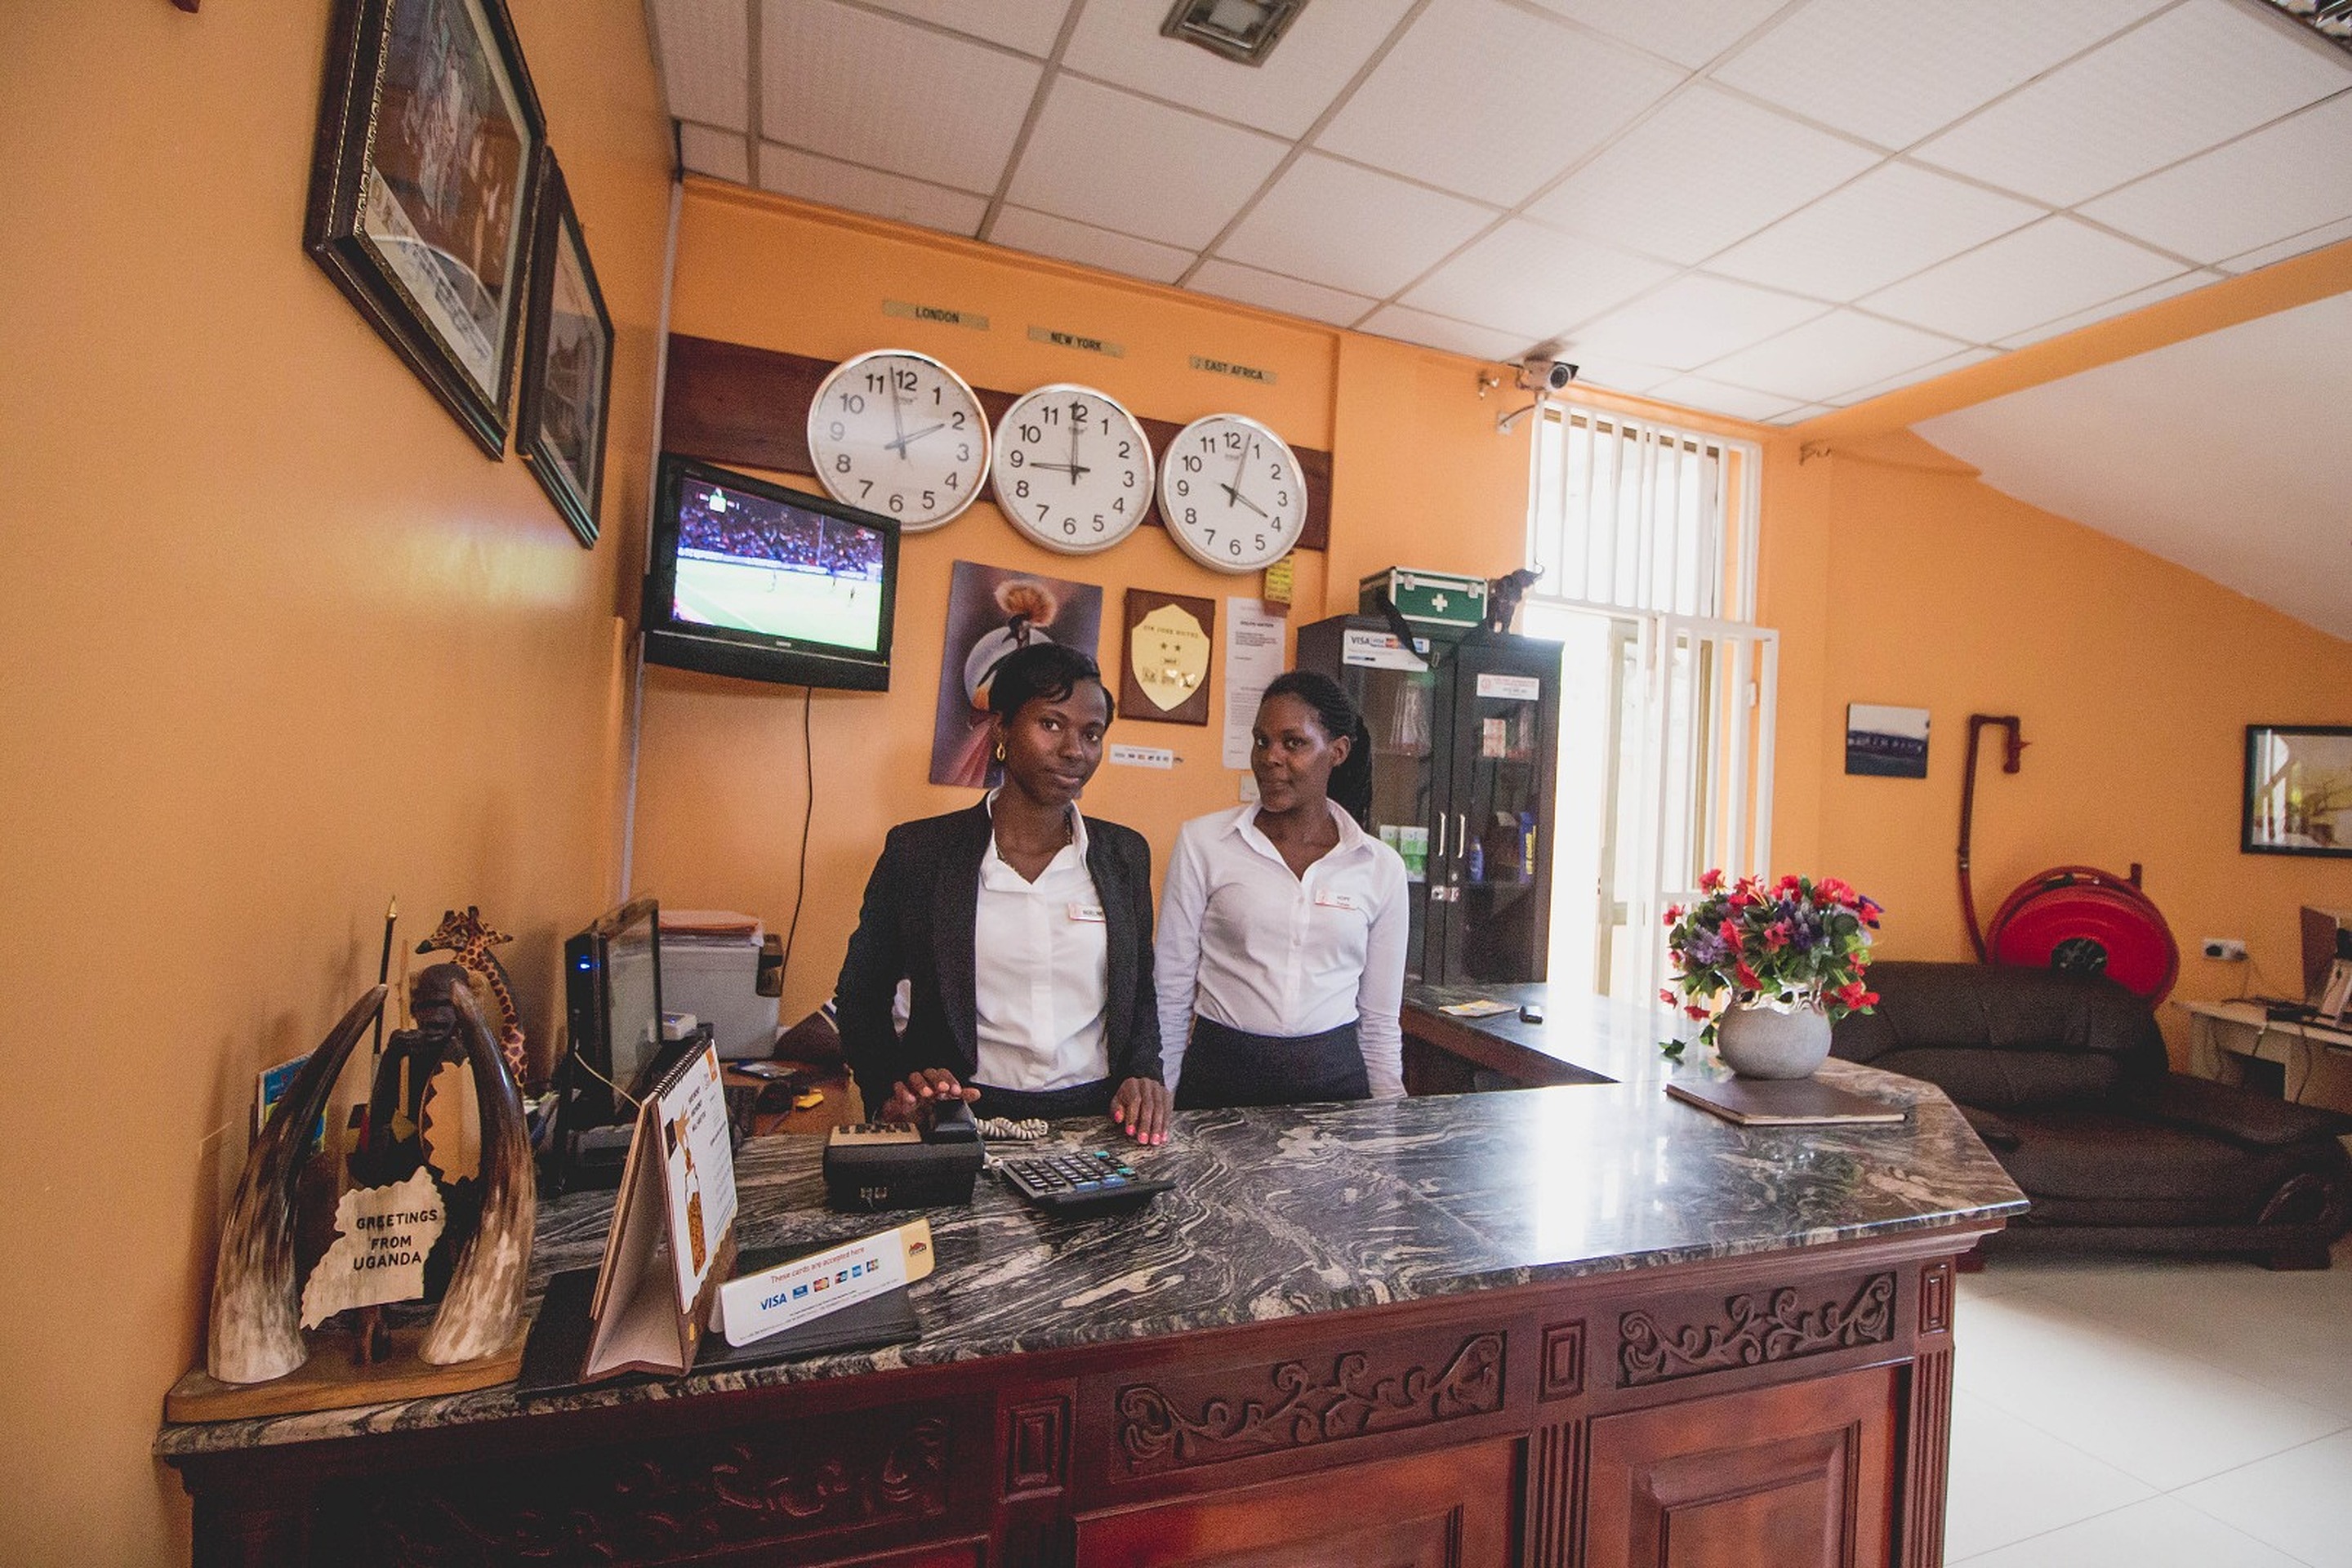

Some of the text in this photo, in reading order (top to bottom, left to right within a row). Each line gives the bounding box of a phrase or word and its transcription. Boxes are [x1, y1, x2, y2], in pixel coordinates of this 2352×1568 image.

[915, 306, 960, 324] LONDON
[1050, 332, 1102, 352] NEW YORK
[1205, 359, 1263, 380] EAST AFRICA
[866, 373, 884, 394] 11
[896, 370, 918, 391] 12
[840, 393, 864, 414] 10
[933, 387, 941, 405] 1
[951, 412, 965, 430] 2
[1042, 407, 1058, 425] 11
[1069, 403, 1088, 423] 12
[830, 421, 845, 441] 9
[1019, 424, 1041, 443] 10
[1102, 419, 1109, 435] 1
[1200, 436, 1215, 453] 11
[1223, 432, 1241, 449] 12
[956, 443, 969, 461] 3
[1010, 450, 1023, 468] 9
[1119, 441, 1130, 459] 2
[1254, 444, 1260, 460] 1
[836, 454, 851, 473] 8
[1183, 455, 1202, 472] 10
[1270, 464, 1281, 480] 2
[859, 479, 874, 498] 7
[945, 472, 958, 490] 4
[1016, 480, 1029, 497] 8
[1123, 471, 1134, 488] 3
[1177, 479, 1189, 497] 9
[889, 494, 903, 512] 6
[923, 491, 935, 510] 5
[1112, 497, 1125, 514] 4
[1277, 491, 1288, 507] 3
[1036, 504, 1049, 522] 7
[1185, 508, 1196, 524] 8
[1063, 518, 1076, 535] 6
[1092, 514, 1104, 532] 5
[1271, 516, 1281, 532] 4
[1204, 528, 1215, 546] 7
[1254, 534, 1265, 550] 5
[1229, 540, 1241, 555] 6
[1351, 636, 1370, 644] VISA
[356, 1209, 438, 1230] GREETINGS
[371, 1235, 412, 1250] FROM
[354, 1251, 421, 1271] UGANDA
[770, 1246, 866, 1284] These cards are accepted here
[760, 1293, 788, 1311] VISA
